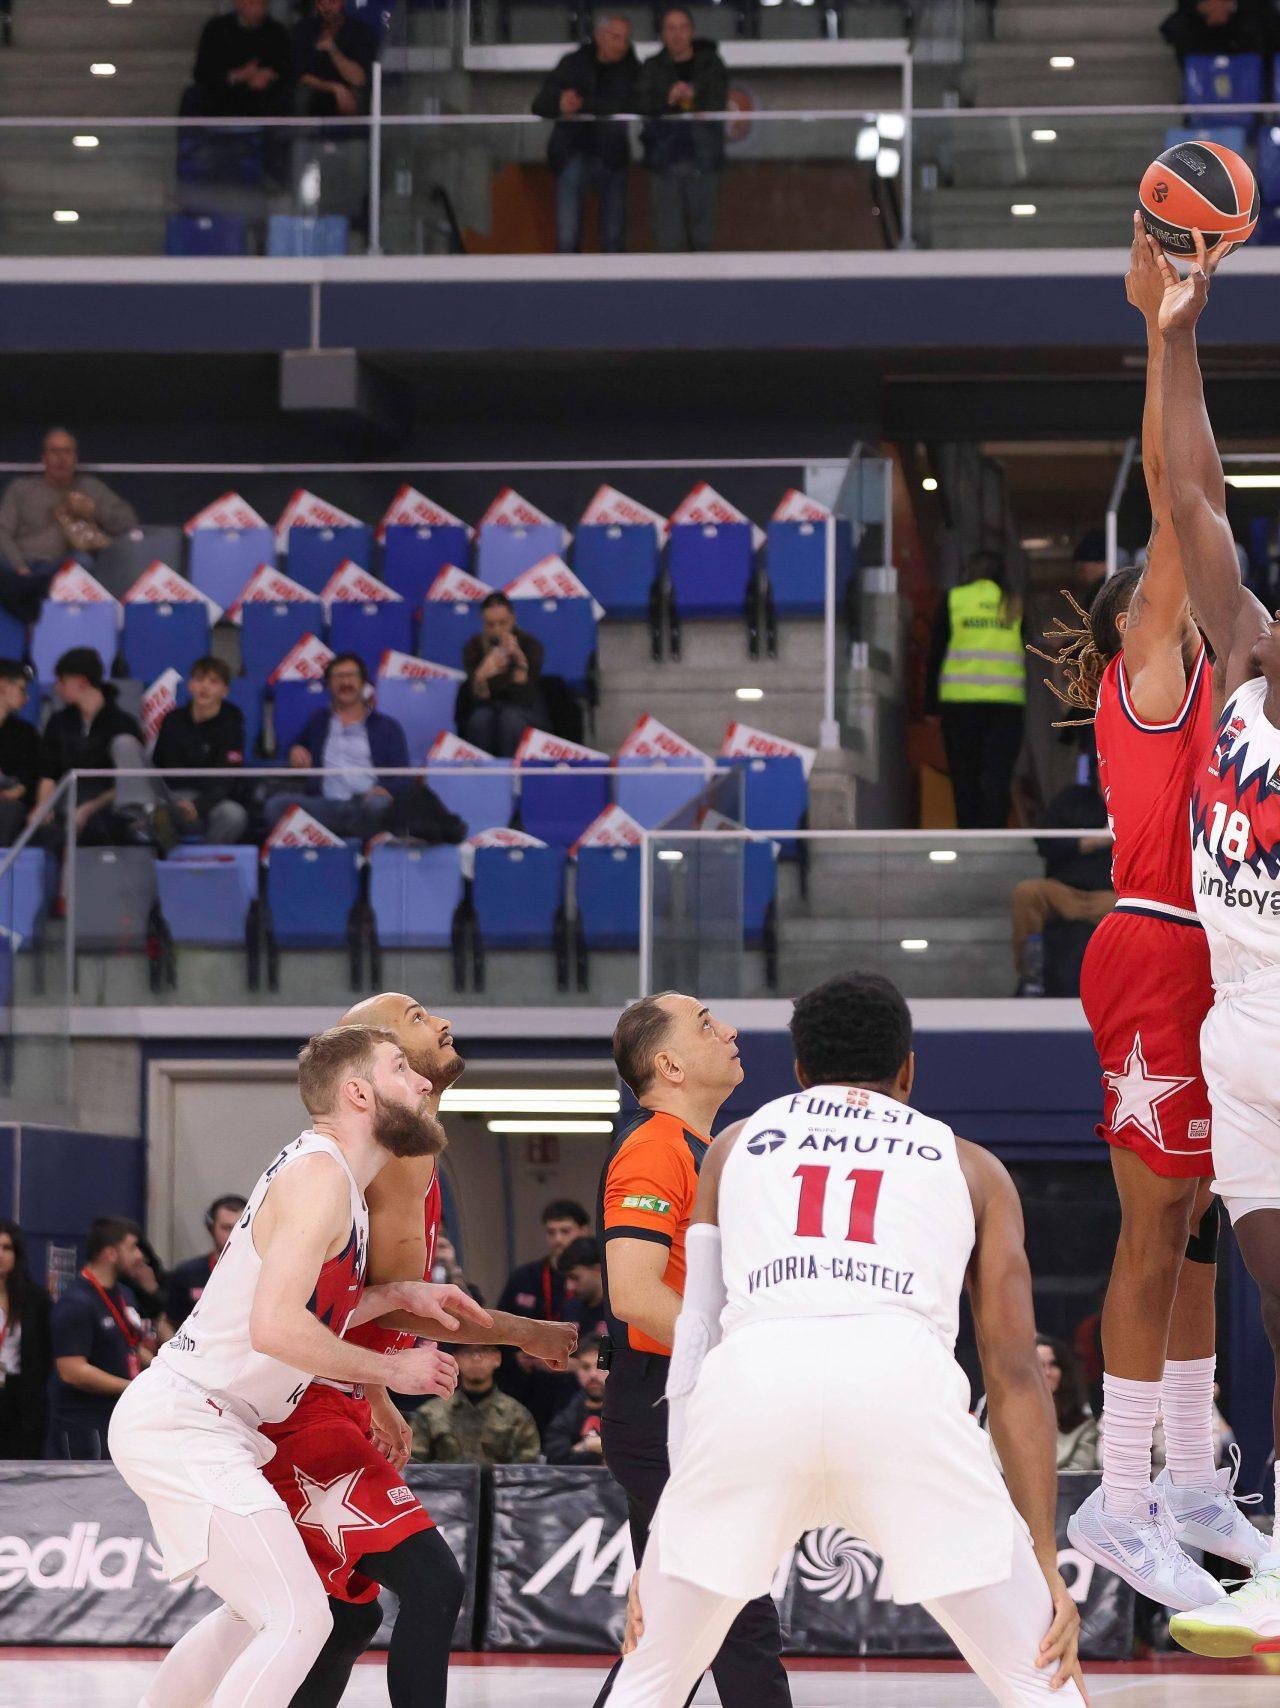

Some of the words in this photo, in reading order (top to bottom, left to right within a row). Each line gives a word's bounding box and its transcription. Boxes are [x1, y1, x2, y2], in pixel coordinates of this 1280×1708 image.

[1209, 801, 1251, 862] 18
[798, 1134, 942, 1161] AMUTIO
[791, 1164, 885, 1245] 11
[0, 1521, 143, 1589] edia
